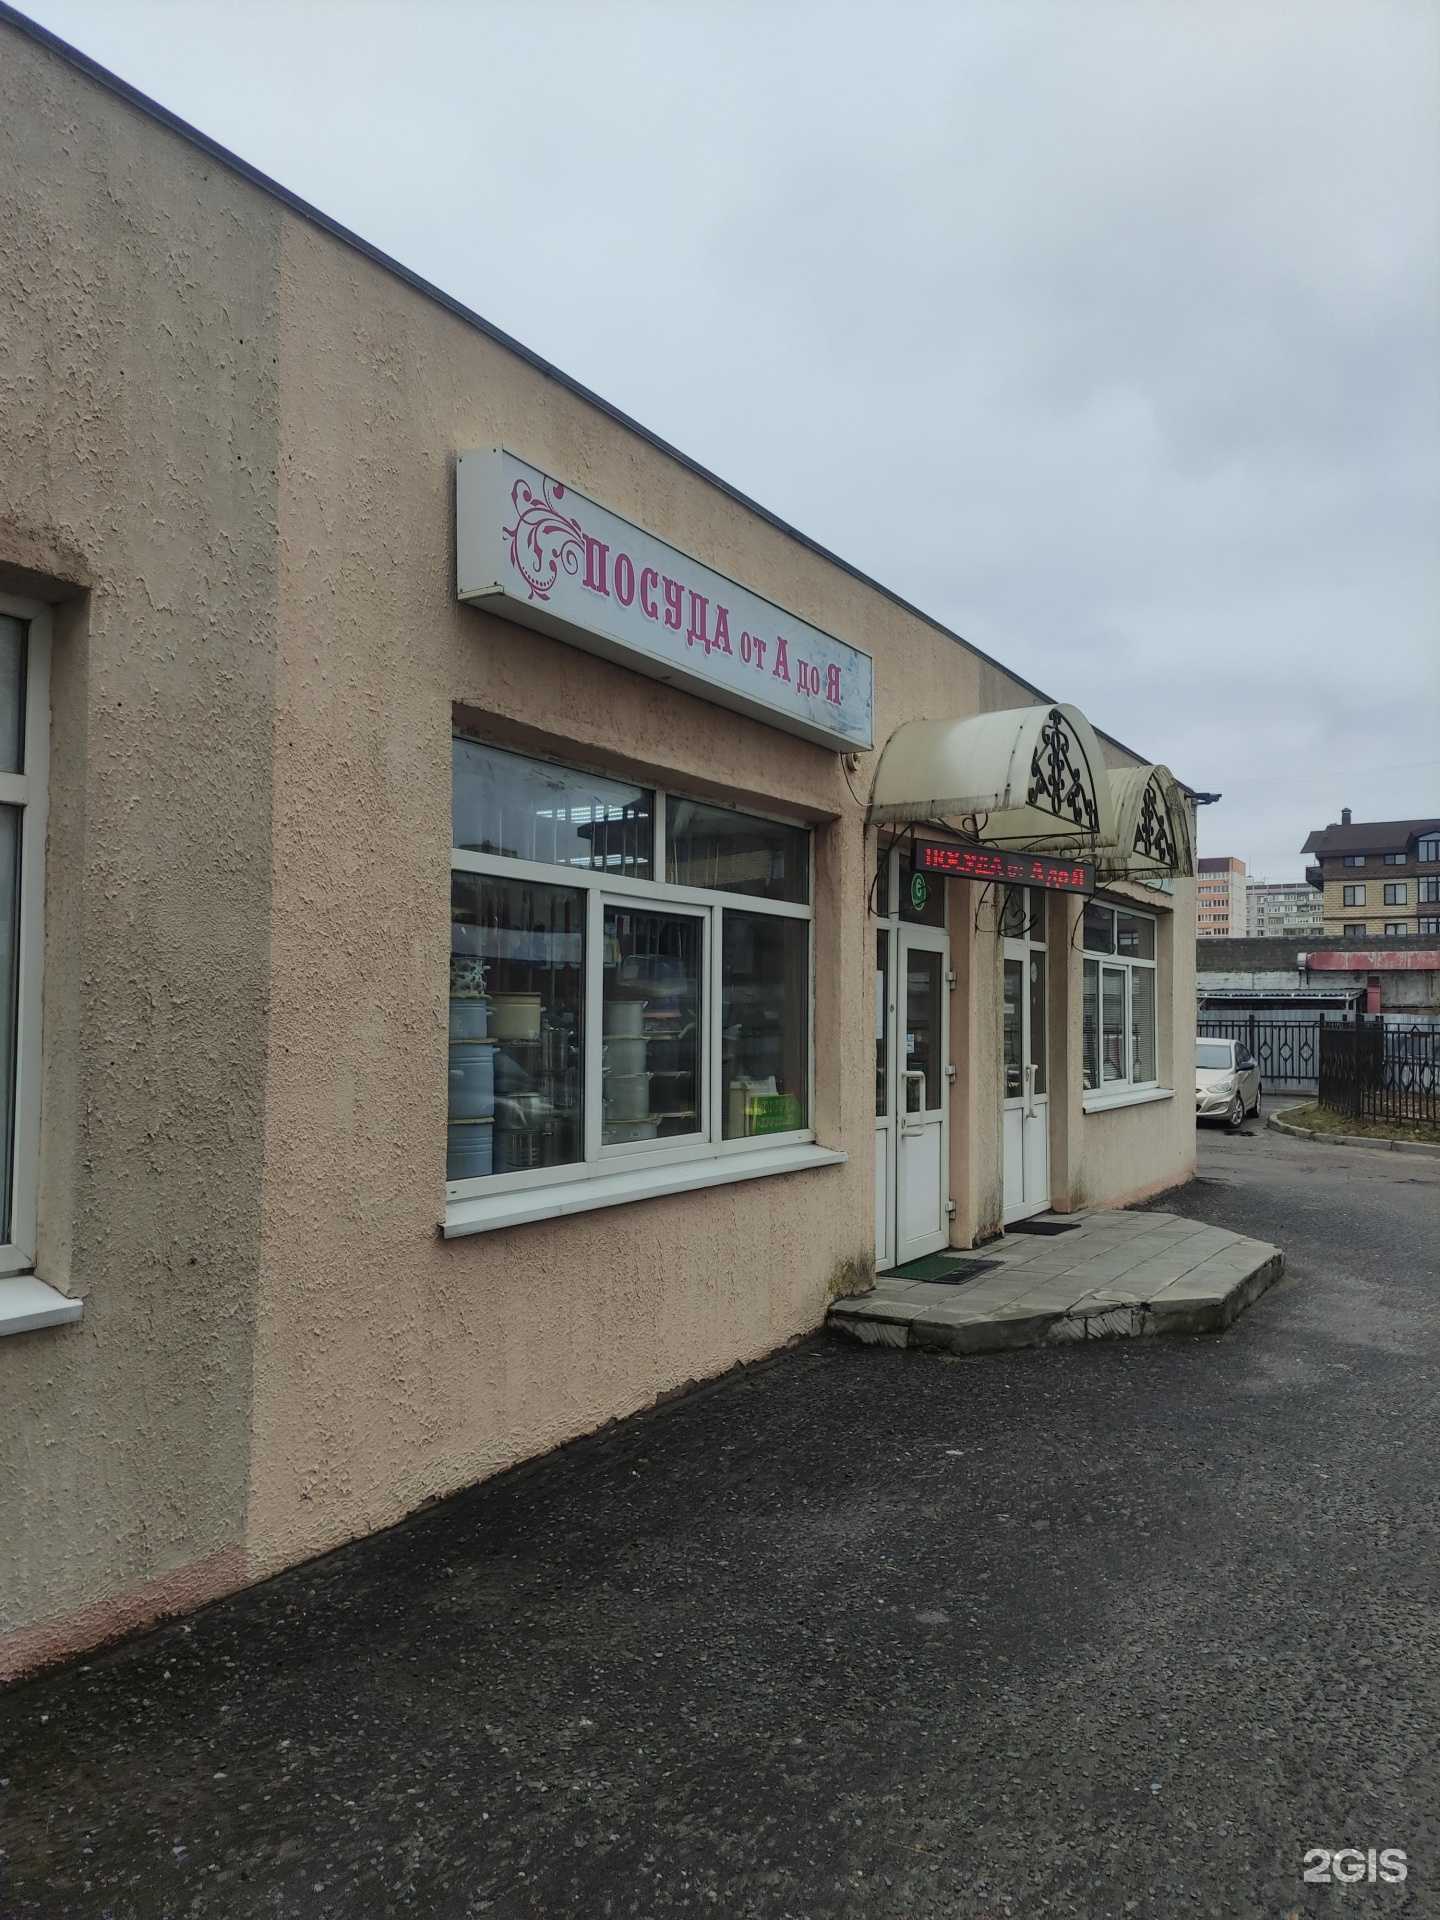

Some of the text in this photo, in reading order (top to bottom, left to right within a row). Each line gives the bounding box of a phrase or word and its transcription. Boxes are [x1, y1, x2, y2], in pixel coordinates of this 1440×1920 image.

[582, 533, 842, 705] ПОСУДА от А до Я
